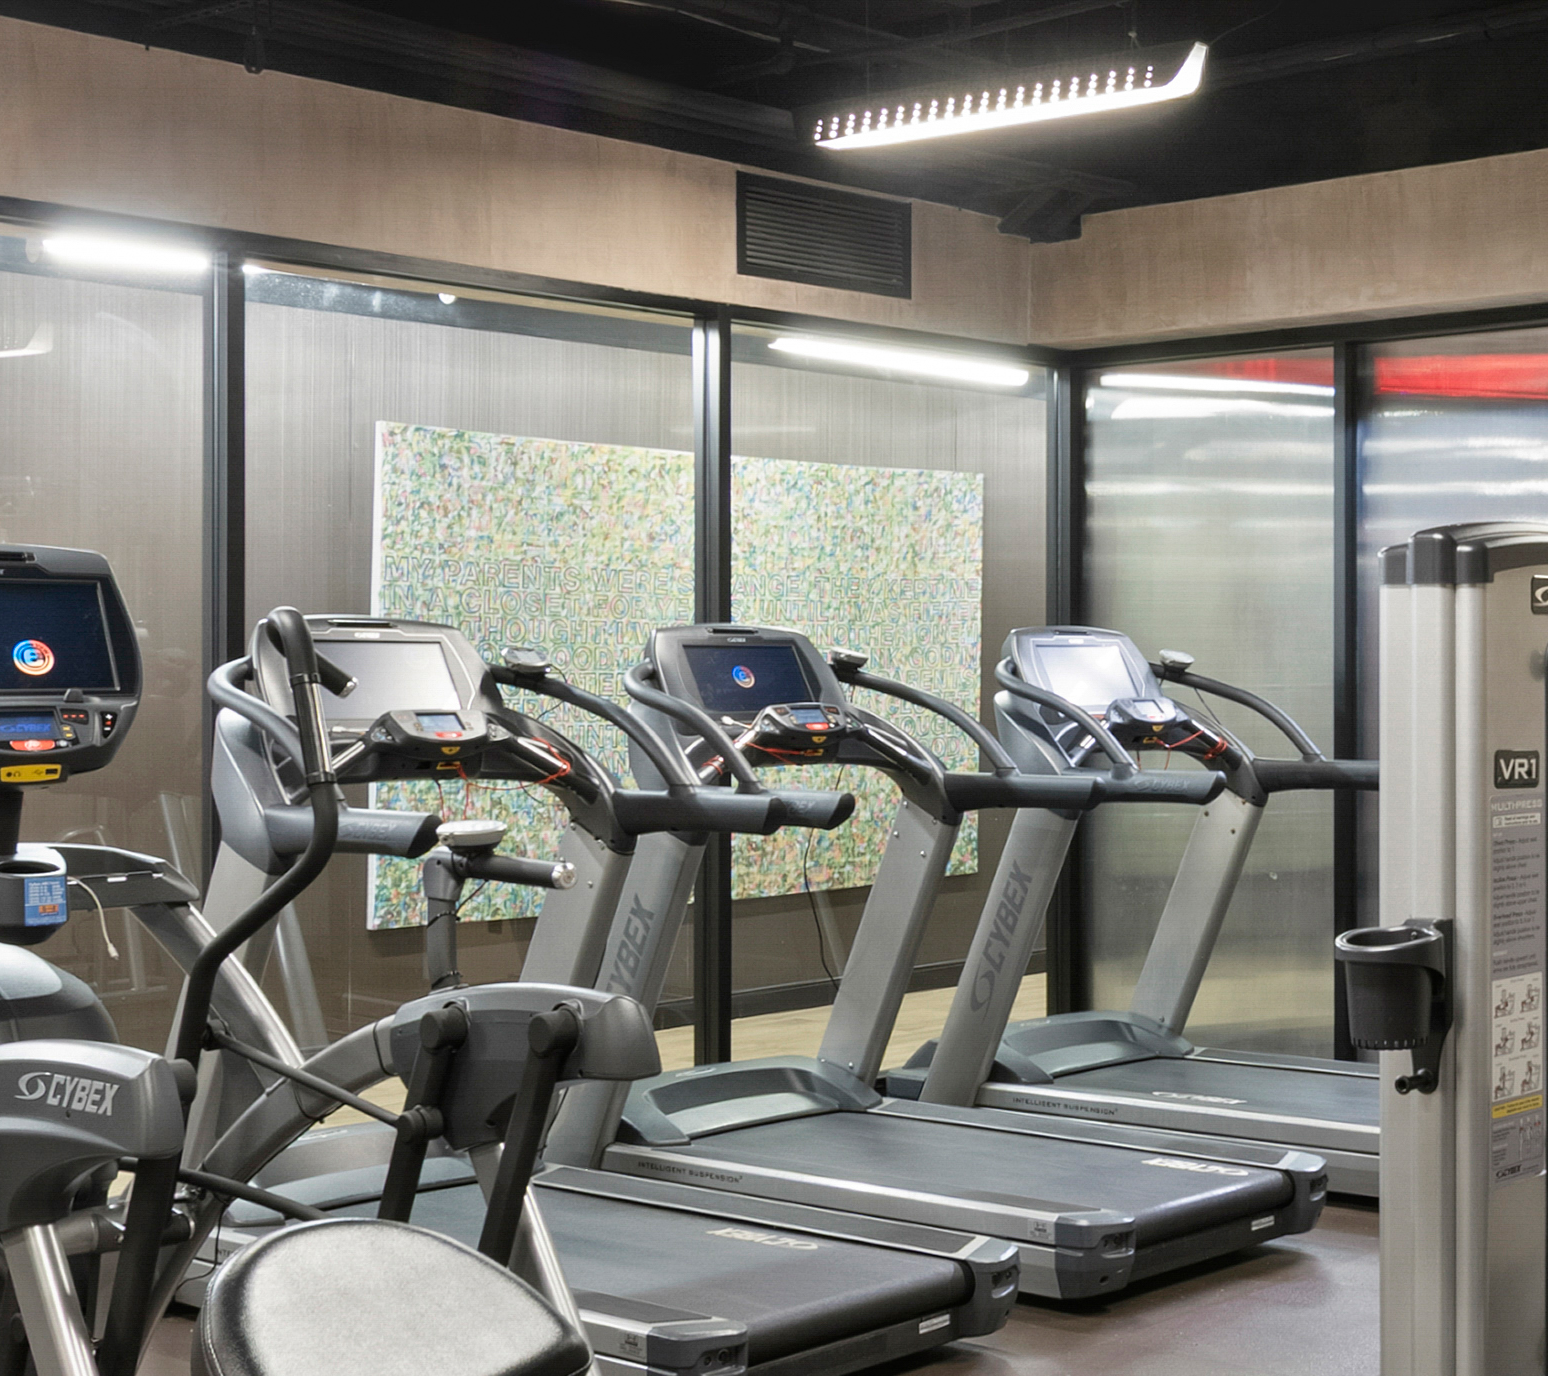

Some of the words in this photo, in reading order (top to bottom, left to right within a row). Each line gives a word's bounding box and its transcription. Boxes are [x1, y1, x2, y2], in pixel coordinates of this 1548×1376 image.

[384, 556, 431, 584] MY
[443, 559, 582, 593] PARENTS
[591, 567, 670, 596] WERE
[885, 578, 943, 601] KEPT
[950, 577, 980, 600] ME
[383, 584, 413, 611] IN
[428, 587, 448, 613] A
[460, 587, 580, 619] CLOSET
[594, 594, 648, 621] FOR
[759, 599, 829, 623] UNTIL
[854, 600, 905, 624] WAS
[1500, 758, 1537, 780] VR1
[983, 859, 1032, 972] CYBEX
[605, 892, 654, 997] YBEX
[46, 1073, 120, 1116] CYBEX
[638, 1162, 687, 1175] INTELLIGENT
